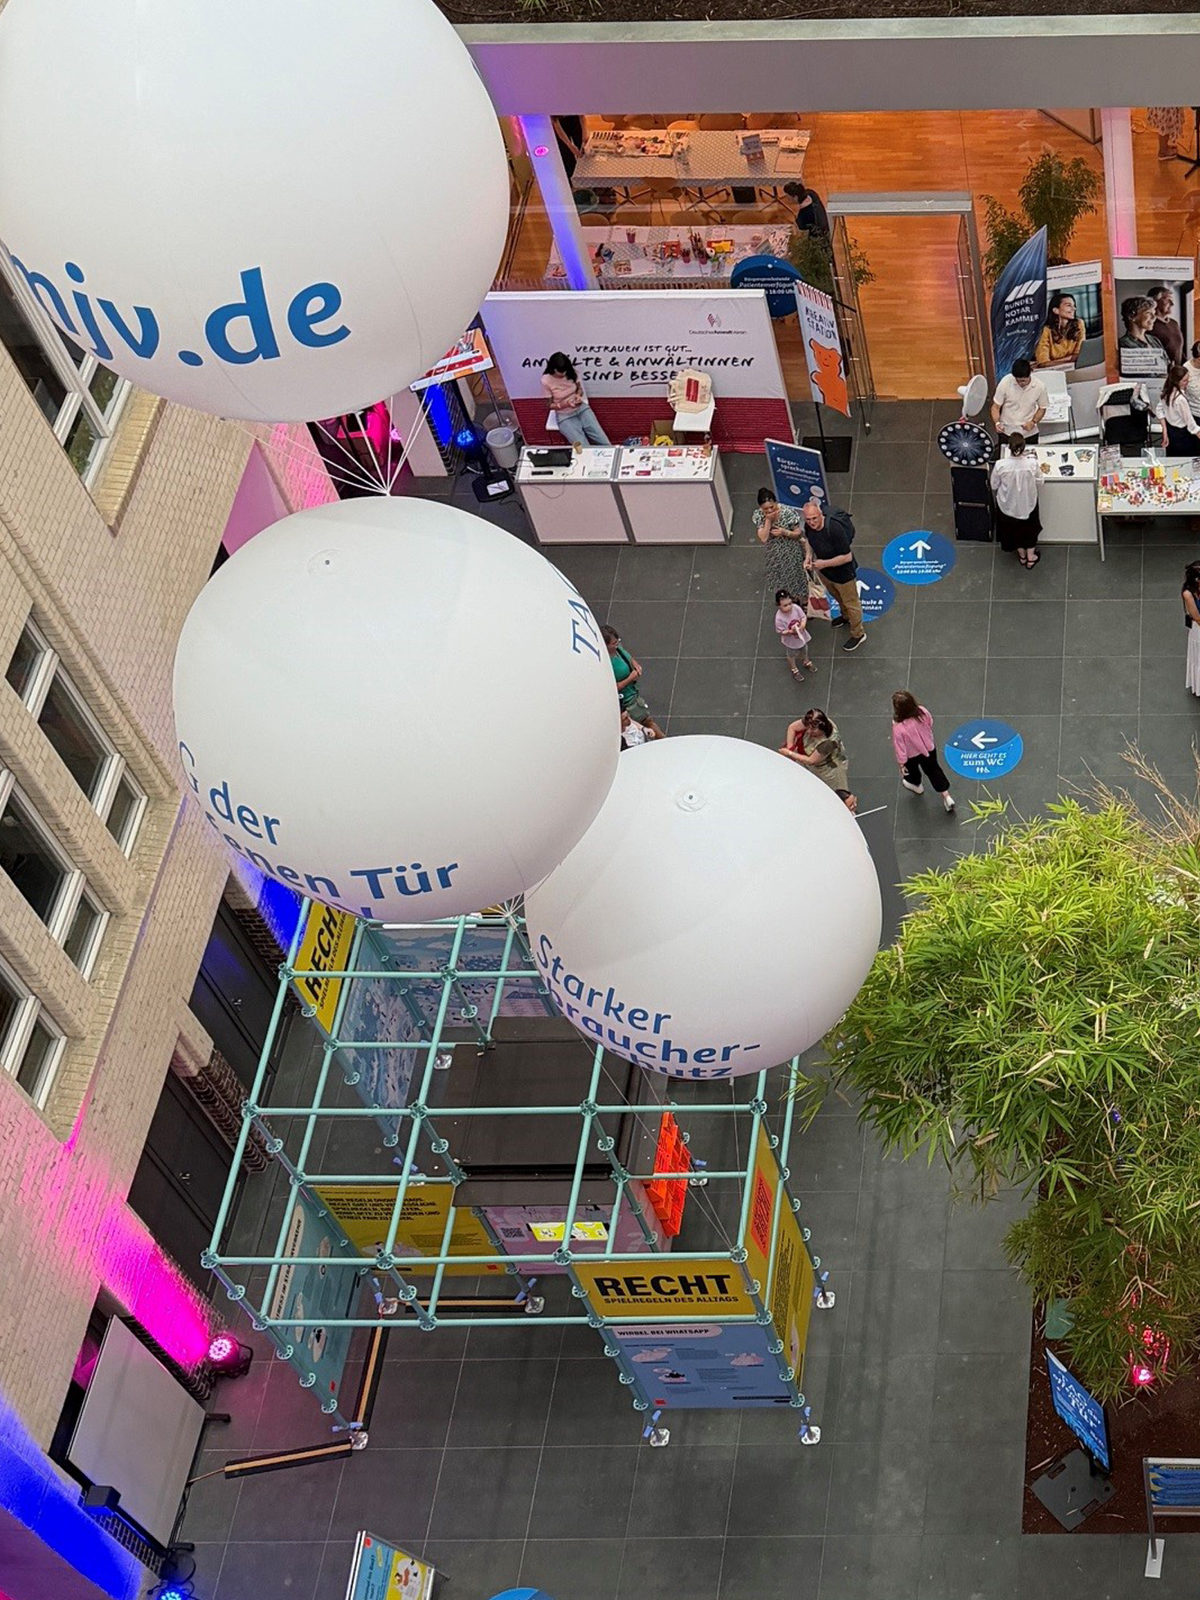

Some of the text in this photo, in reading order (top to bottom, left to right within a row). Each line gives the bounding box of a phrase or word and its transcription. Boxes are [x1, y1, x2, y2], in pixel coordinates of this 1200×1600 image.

[1004, 297, 1034, 311] BUNDES
[1005, 307, 1031, 319] NOTAR
[1005, 314, 1039, 327] KAMMER
[575, 345, 641, 353] VERTRAUEN
[643, 345, 663, 353] IST
[609, 357, 620, 367] &
[625, 353, 754, 368] ANWÄLTINNEN
[583, 370, 677, 381] SIND BESSE
[986, 758, 1004, 766] WC
[209, 781, 280, 845] der
[350, 862, 459, 900] Tür
[536, 934, 672, 1034] Starker
[593, 1275, 731, 1297] RECHT
